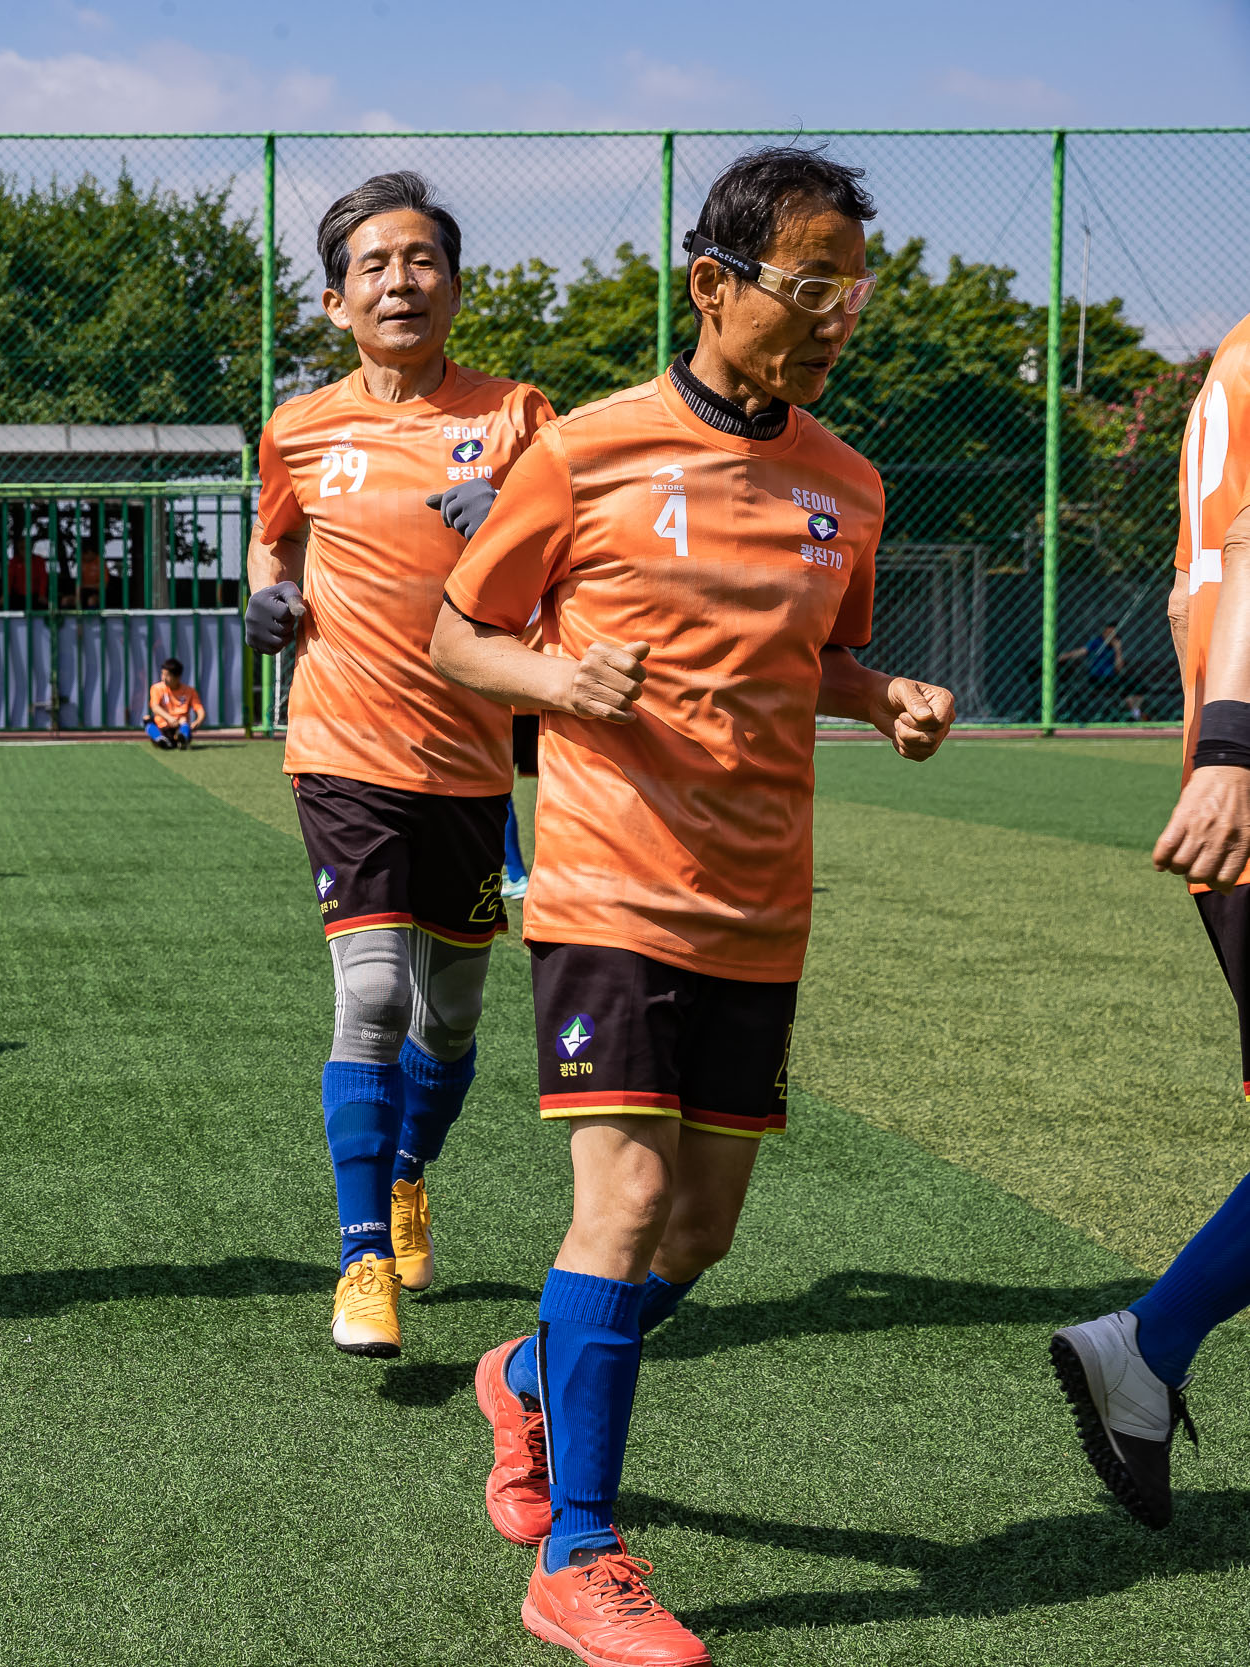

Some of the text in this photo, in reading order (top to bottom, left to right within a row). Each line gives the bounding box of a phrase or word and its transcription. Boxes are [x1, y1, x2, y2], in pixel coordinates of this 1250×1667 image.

[442, 425, 490, 440] SEOUL
[319, 449, 368, 498] 29
[446, 465, 493, 481] 광진70
[791, 487, 841, 515] SEOUL
[653, 494, 688, 556] 4
[800, 543, 843, 570] 광진70
[328, 899, 339, 910] 70
[559, 1061, 594, 1077] 광진 70
